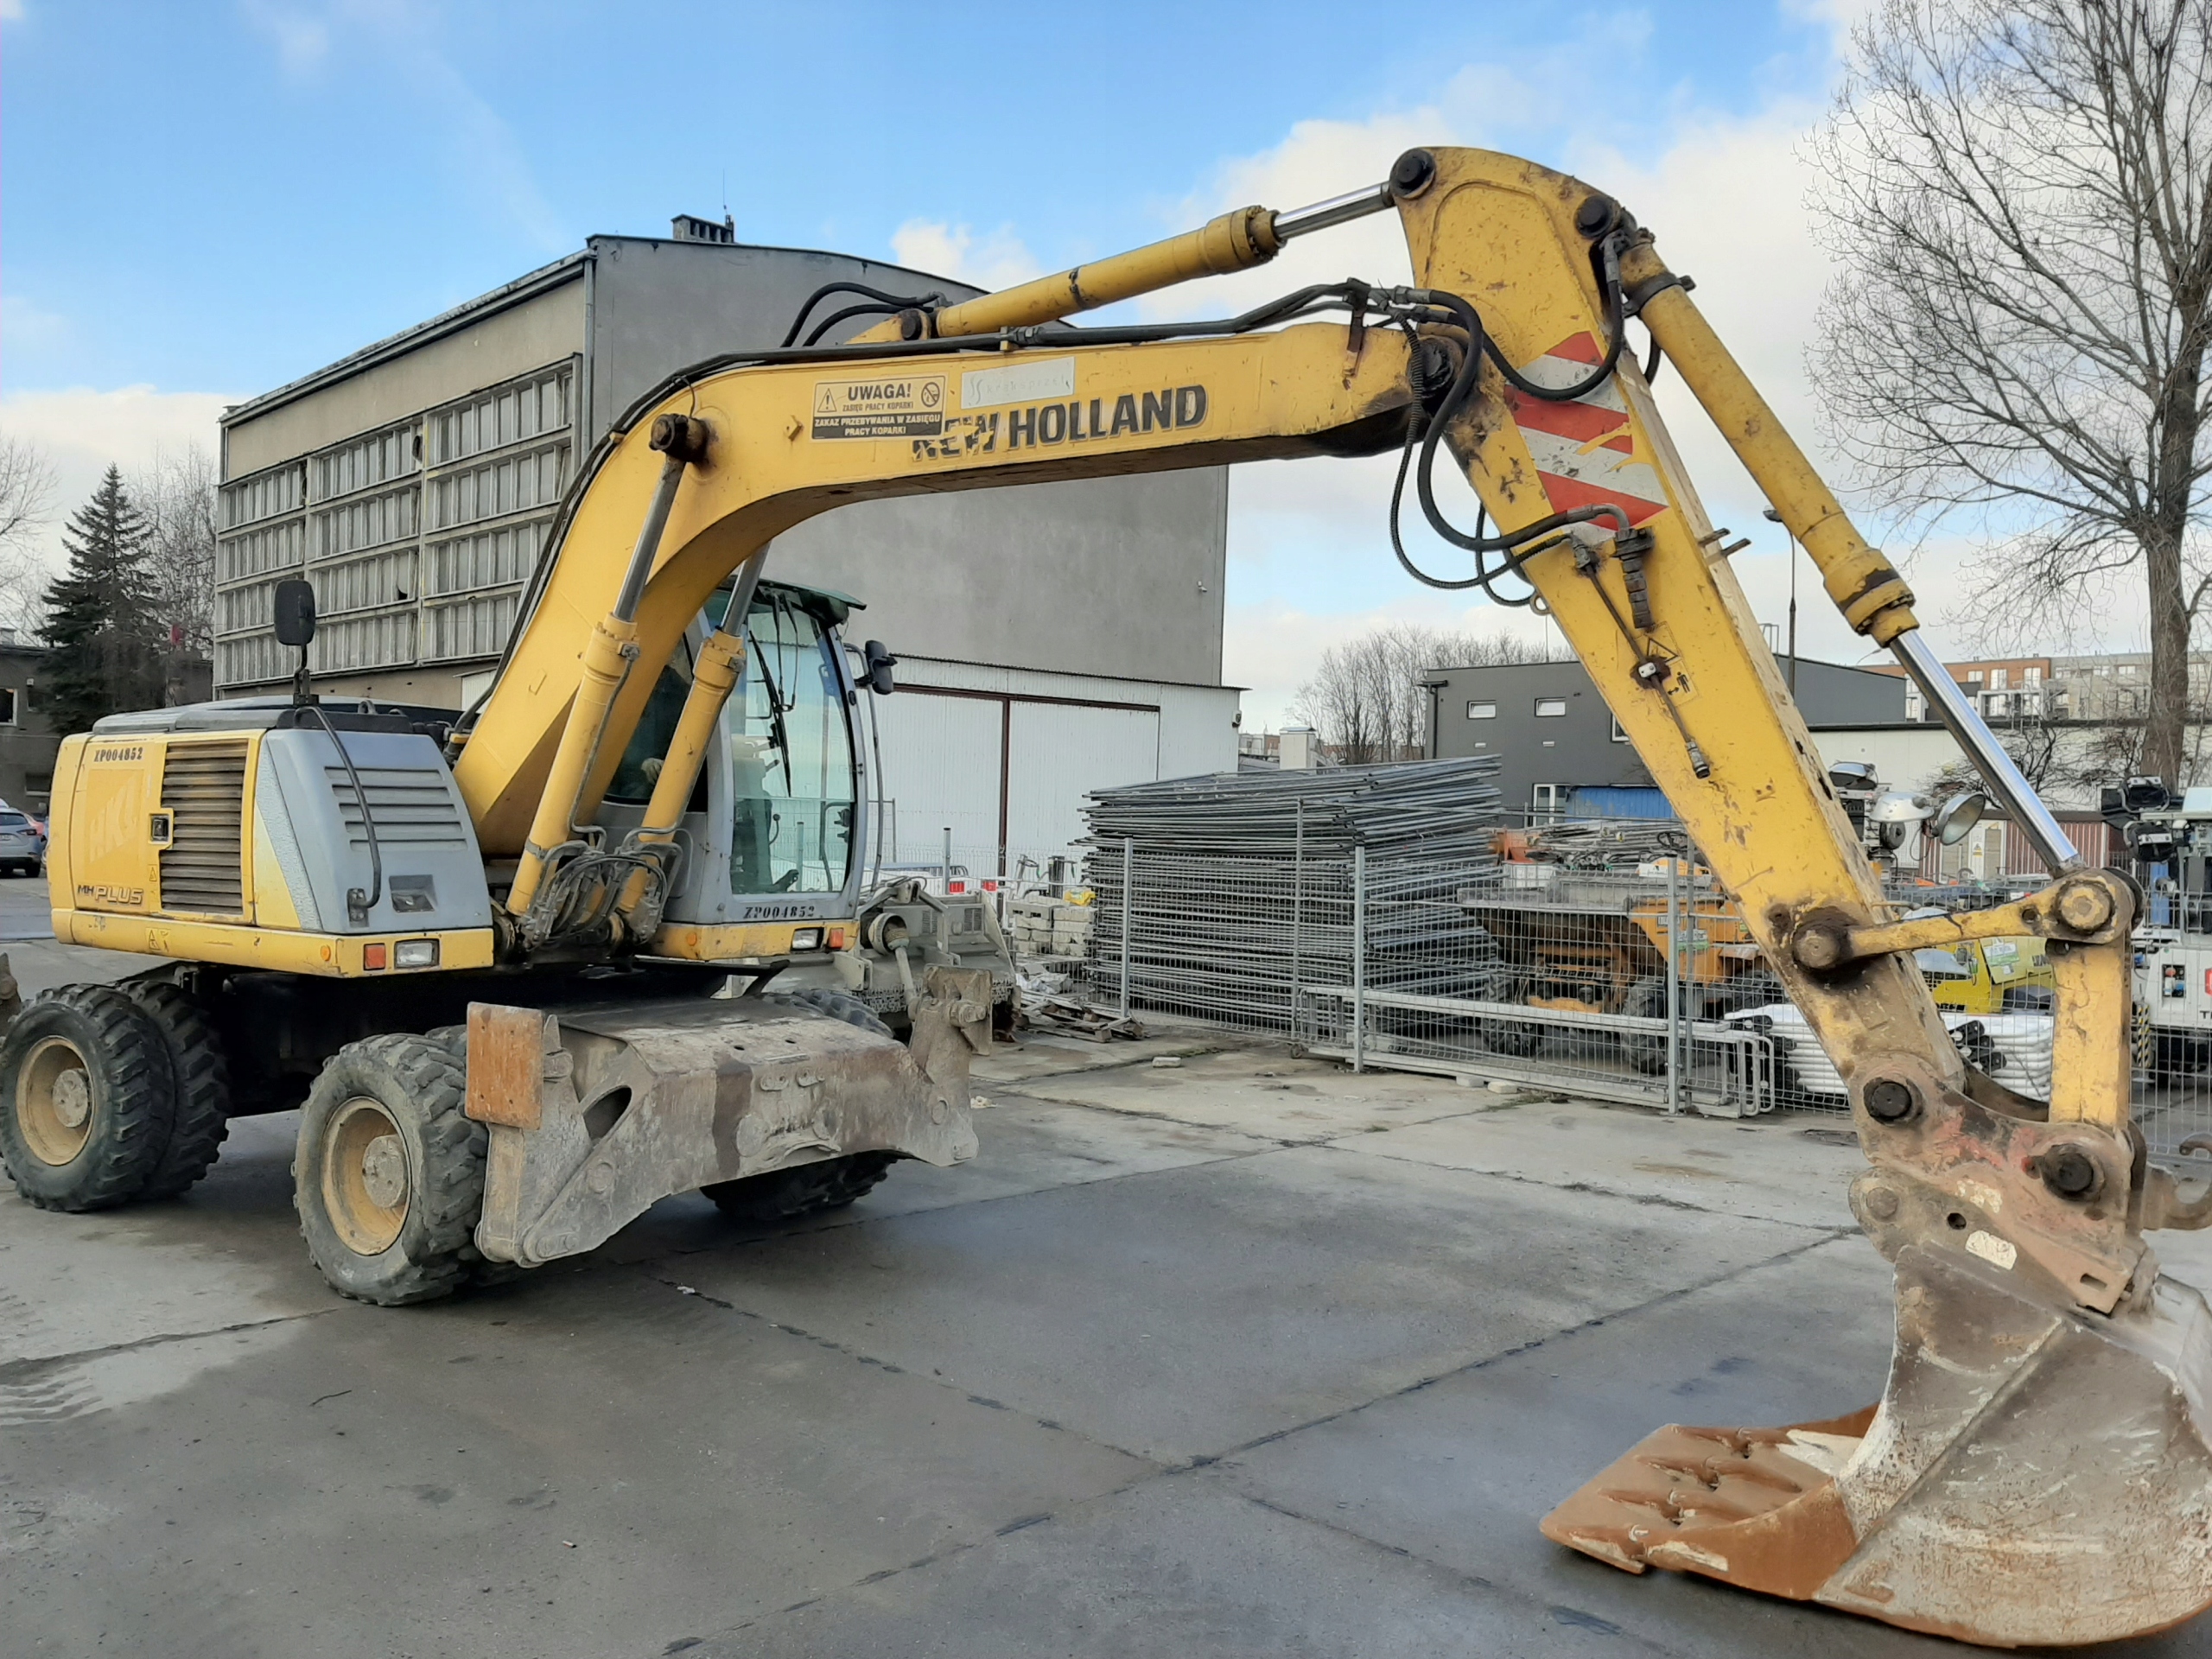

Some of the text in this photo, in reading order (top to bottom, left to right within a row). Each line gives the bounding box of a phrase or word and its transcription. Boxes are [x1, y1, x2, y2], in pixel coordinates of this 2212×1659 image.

[848, 383, 912, 401] UWAGA!
[865, 402, 885, 411] PRACY
[887, 401, 914, 410] KOPARKI
[815, 414, 941, 428] ZAKAZ PRZEBYWANIA W ZASIĘGU
[1008, 384, 1209, 450] HOLLAND
[844, 426, 906, 436] PRACY KOPARKI
[78, 884, 143, 905] MH PLUS
[743, 906, 815, 918] ZP004852
[2199, 1010, 2212, 1020] T
